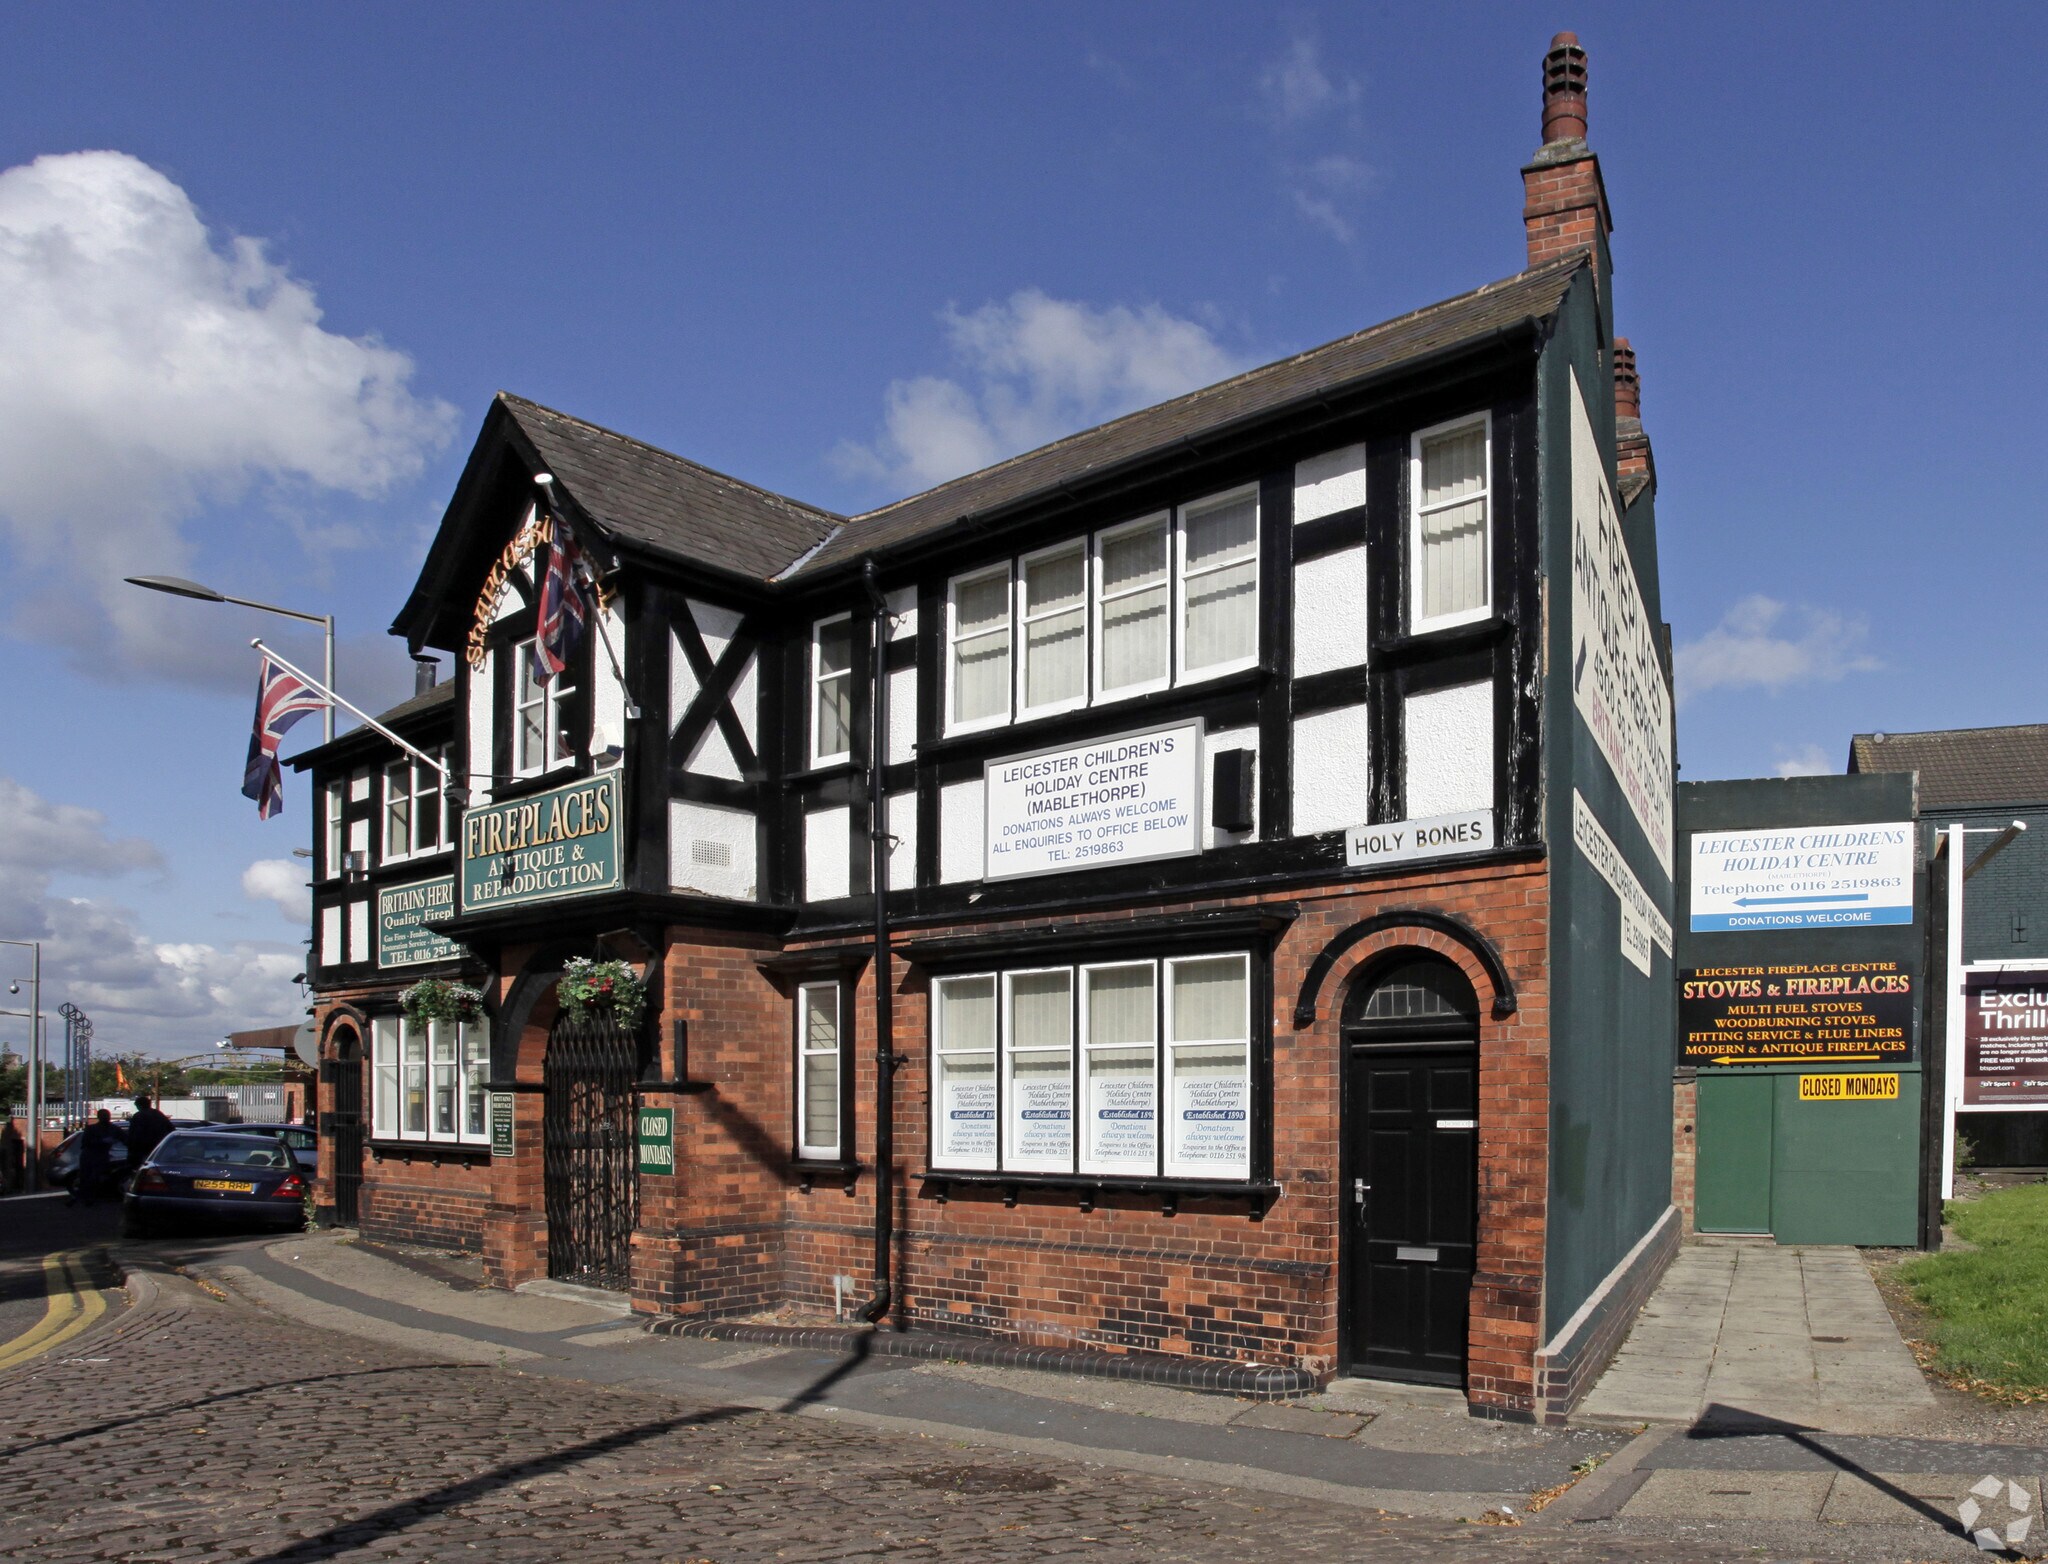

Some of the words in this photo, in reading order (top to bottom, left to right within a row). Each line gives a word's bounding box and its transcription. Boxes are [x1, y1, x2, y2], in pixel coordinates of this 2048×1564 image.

[1575, 517, 1620, 682] ANTIQUE
[1598, 476, 1661, 727] FIREPLACES
[1594, 649, 1614, 715] 4500
[1003, 756, 1079, 783] LEICESTER
[1084, 738, 1175, 768] CHILDREN'S
[1025, 774, 1083, 797] HOLIDAY
[1088, 762, 1148, 785] CENTRE
[1027, 782, 1146, 816] (MABLETHORPE)
[467, 784, 611, 860] FIREPLACES
[1003, 816, 1064, 836] DONATIONS
[1068, 808, 1111, 826] ALWAYS
[1116, 798, 1177, 818] WELCOME
[993, 843, 1011, 854] ALL
[1015, 832, 1073, 851] ENQUIRIES
[1077, 829, 1092, 841] TO
[1097, 822, 1138, 839] OFFICE
[1144, 814, 1188, 831] BELOW
[1355, 832, 1404, 855] HOLY
[1416, 821, 1483, 848] BONES
[1576, 802, 1608, 876] LEICESTER
[1699, 836, 1795, 855] LEICESTER
[1800, 830, 1906, 849] CHILDRENS
[1048, 850, 1070, 862] TEL:
[1075, 841, 1124, 858] 2519863
[488, 845, 565, 878] ANTIQUE
[571, 844, 585, 861] &
[1723, 855, 1803, 872] HOLIDAY
[1807, 851, 1879, 868] CENTRE
[473, 861, 605, 901] REPRODUCTION
[1768, 870, 1831, 880] (MABLETHORPE)
[1702, 882, 1785, 896] Telephone
[1790, 880, 1826, 891] 0116
[1831, 877, 1901, 890] 2519863
[382, 888, 425, 915] BRITAINS
[385, 911, 421, 930] Quality
[1729, 915, 1802, 927] DONATIONS
[1806, 912, 1872, 924] WELCOME
[394, 933, 406, 941] Fires
[410, 929, 429, 939] Fenders
[409, 939, 426, 948] Service
[390, 950, 412, 963] TEL:
[414, 948, 431, 961] 0116
[433, 946, 447, 957] 251
[1696, 966, 1764, 977] LEICESTER
[1768, 964, 1838, 975] FIREPLACE
[1841, 962, 1896, 972] CENTRE
[1684, 979, 1761, 999] STOVES
[1767, 983, 1781, 997] &
[1786, 975, 1910, 996] FIREPLACES
[1728, 1005, 1771, 1015] MULTI
[1775, 1004, 1808, 1014] FUEL
[1811, 1002, 1862, 1012] STOVES
[1714, 1017, 1821, 1028] WOODBURNING
[1824, 1015, 1876, 1026] STOVES
[1979, 1009, 2048, 1029] Thrill
[1689, 1031, 1743, 1042] FITTING
[1747, 1030, 1801, 1041] SERVICE
[1805, 1031, 1814, 1039] &
[1817, 1029, 1851, 1039] FLUE
[1855, 1027, 1902, 1038] LINERS
[1685, 1044, 1744, 1055] MODERN
[1748, 1045, 1757, 1054] &
[1761, 1042, 1824, 1055] ANTIQUE
[1827, 1041, 1906, 1052] FIREPLACES
[1183, 1081, 1212, 1089] Leicester
[1802, 1078, 1841, 1097] CLOSED
[1846, 1077, 1896, 1096] MONDAYS
[956, 1092, 977, 1101] Holiday
[1028, 1091, 1051, 1101] Holiday
[1106, 1090, 1131, 1100] Holiday
[1132, 1091, 1152, 1099] Centre
[1190, 1090, 1217, 1101] Holiday
[1218, 1090, 1240, 1099] Centre
[1107, 1099, 1150, 1108] (Mablethorpe)
[1191, 1099, 1238, 1108] (Mablethorpe)
[954, 1111, 984, 1119] Established
[1025, 1111, 1059, 1119] Established
[1103, 1111, 1140, 1119] Established
[1186, 1111, 1227, 1119] Established
[1228, 1111, 1245, 1119] 1898
[641, 1116, 667, 1136] CLOSED
[961, 1122, 991, 1130] Donations
[1033, 1122, 1066, 1130] Donations
[1111, 1122, 1146, 1130] Donations
[1196, 1123, 1235, 1132] Donations
[1024, 1130, 1046, 1140] always
[1102, 1131, 1126, 1141] always
[1186, 1131, 1211, 1143] always
[1213, 1131, 1245, 1141] welcome
[640, 1144, 671, 1165] MONDAYS
[1224, 1143, 1240, 1153] Office
[1210, 1152, 1224, 1160] 0116
[1226, 1152, 1236, 1160] 251
